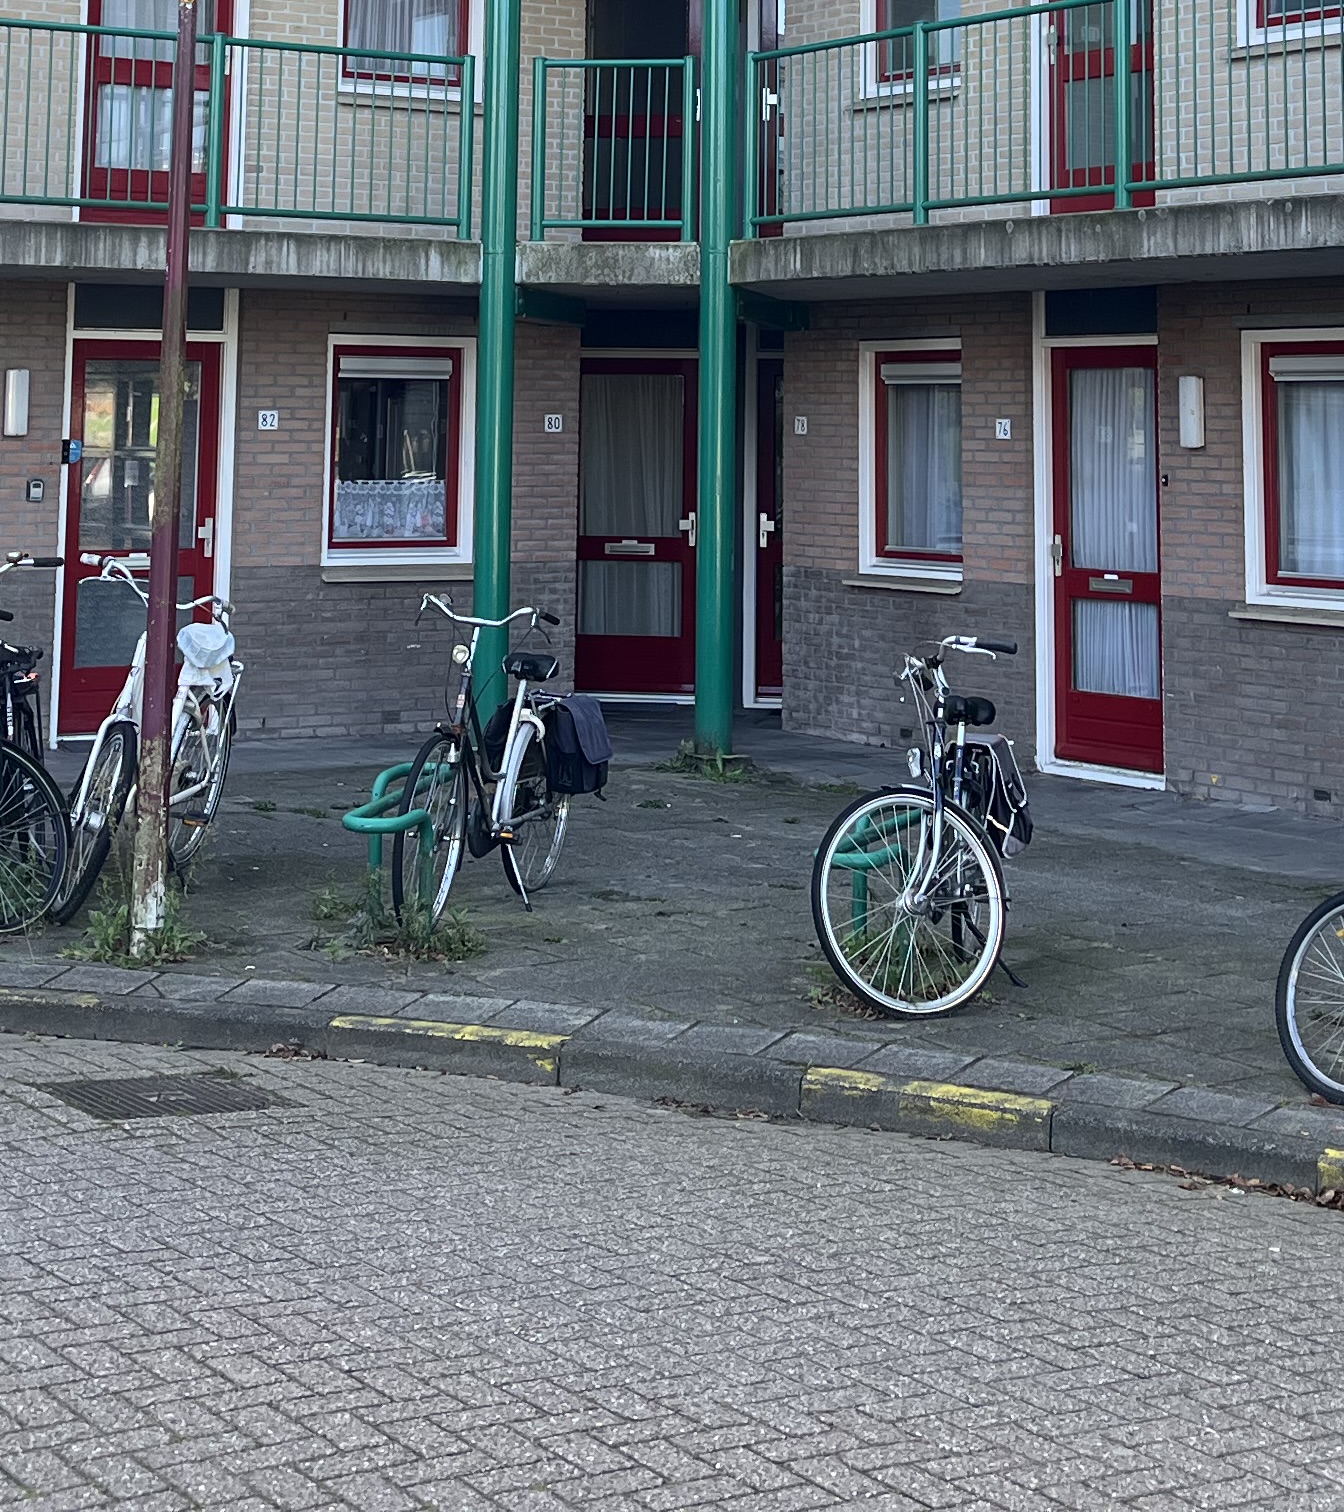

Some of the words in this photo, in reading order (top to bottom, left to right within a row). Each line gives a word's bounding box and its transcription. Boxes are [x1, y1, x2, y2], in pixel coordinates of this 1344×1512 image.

[261, 413, 276, 428] 82
[546, 416, 561, 430] 80
[796, 418, 806, 433] 78
[997, 421, 1009, 437] 76
